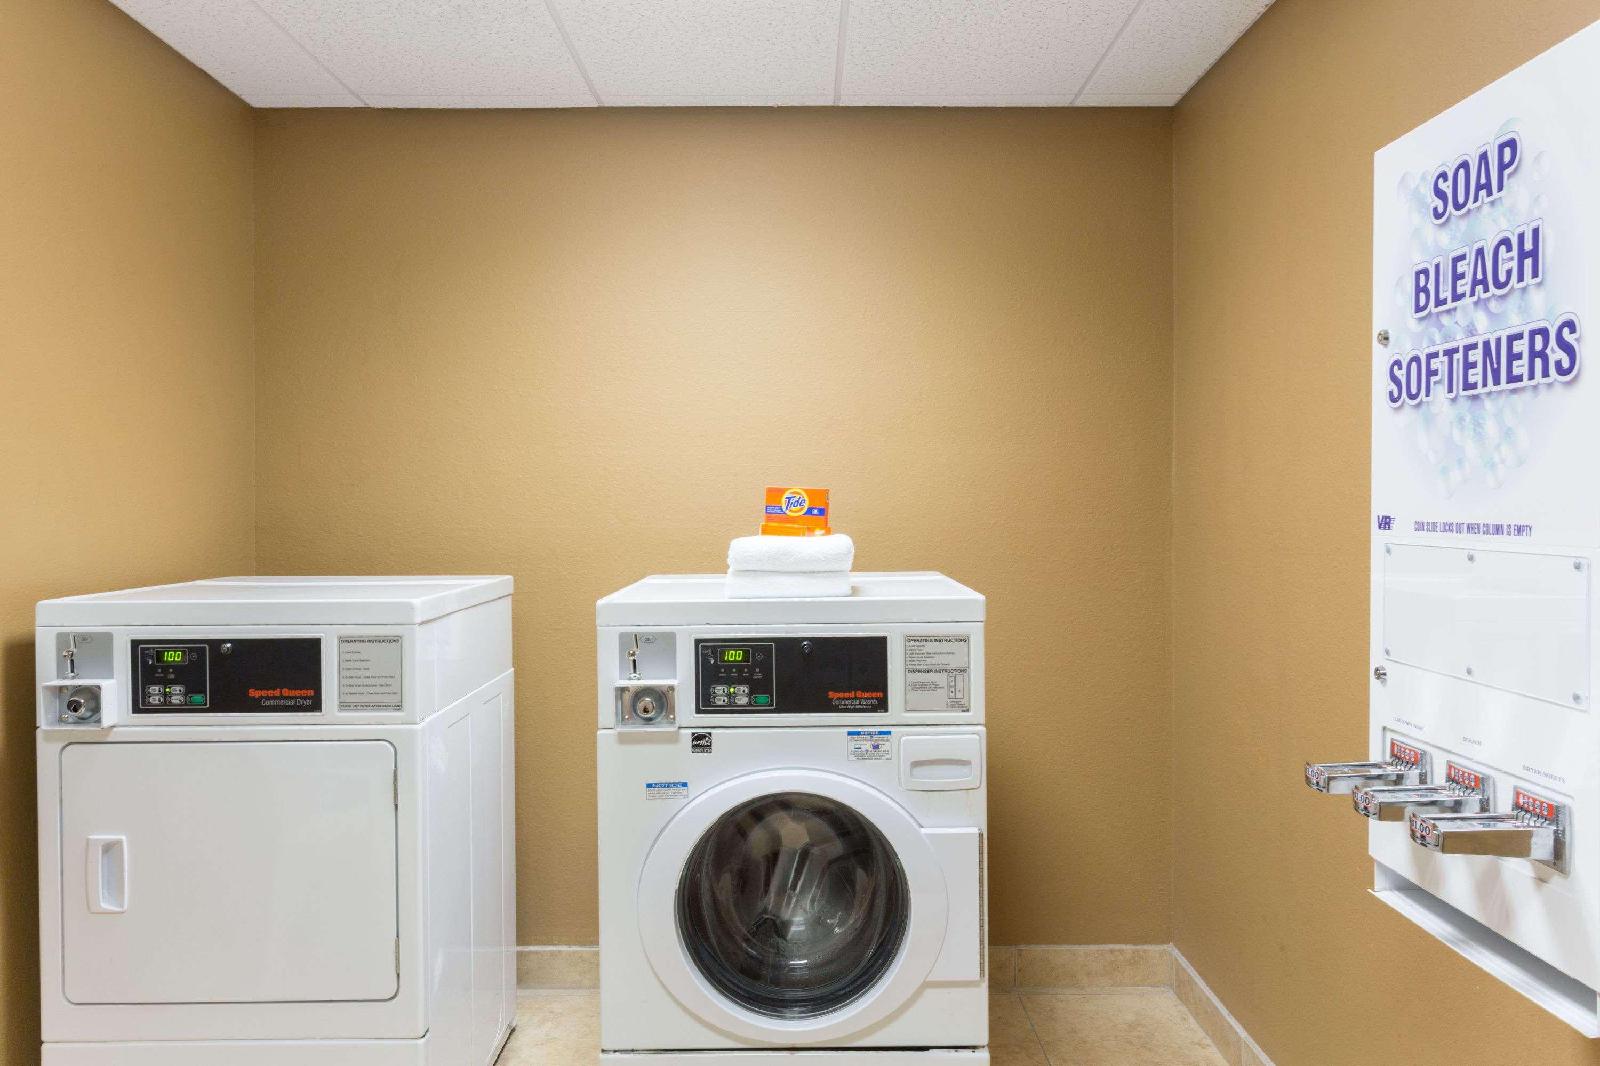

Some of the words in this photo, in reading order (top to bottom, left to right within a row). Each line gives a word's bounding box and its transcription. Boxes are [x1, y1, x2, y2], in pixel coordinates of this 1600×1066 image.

[1431, 137, 1519, 222] SOAP
[1413, 224, 1541, 316] BLEACH
[1388, 318, 1578, 404] SOFTENERS
[785, 495, 807, 510] Tide
[1414, 521, 1425, 532] COIN
[1426, 521, 1438, 533] SLIDE
[1439, 522, 1454, 534] LOCKS
[1455, 522, 1465, 534] OUT
[1466, 522, 1481, 535] WHEN
[1482, 523, 1504, 536] COLUMN
[1506, 524, 1512, 536] IS
[1513, 524, 1533, 537] EMPTY
[164, 651, 182, 661] 100
[724, 650, 743, 661] 100
[248, 688, 281, 698] Speed
[282, 688, 314, 697] Queen
[828, 690, 855, 699] Speed
[856, 690, 884, 698] Queen
